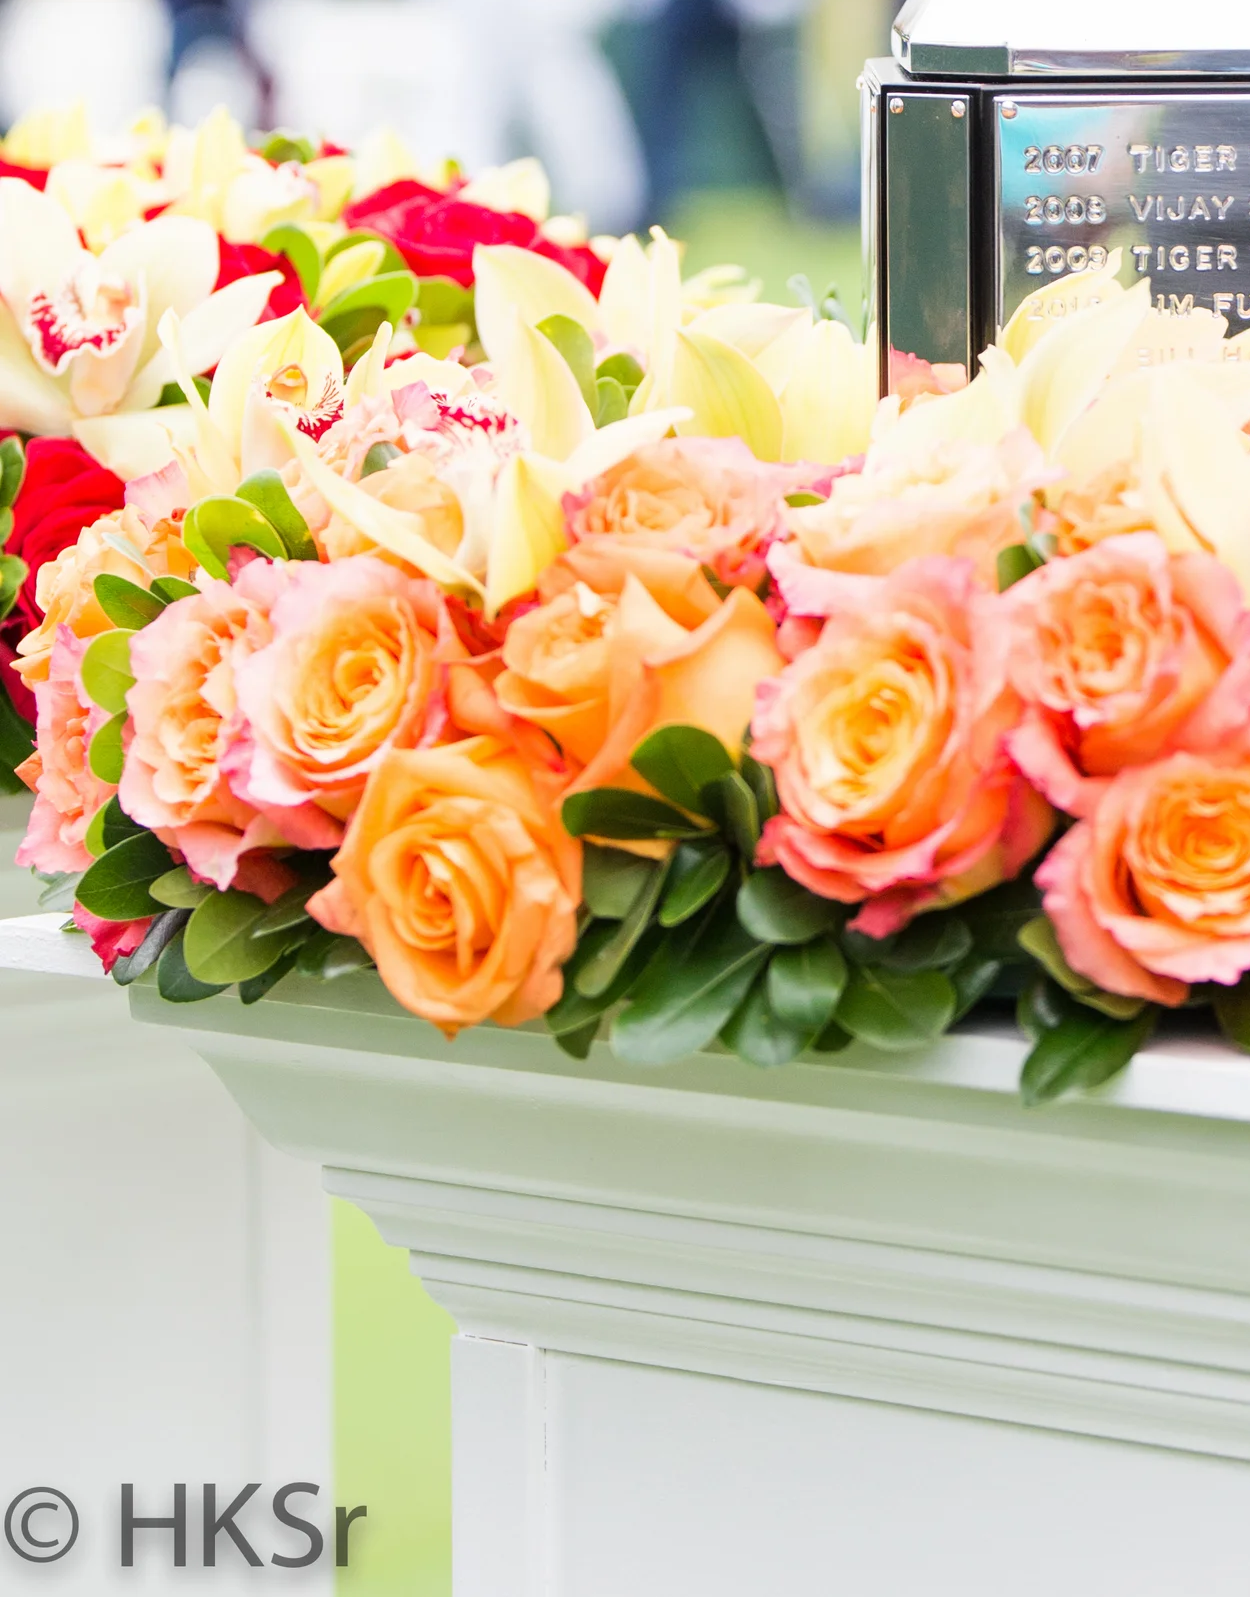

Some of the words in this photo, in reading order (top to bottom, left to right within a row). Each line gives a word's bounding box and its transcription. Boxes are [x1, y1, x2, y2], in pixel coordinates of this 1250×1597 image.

[1024, 145, 1105, 174] 2007
[1127, 144, 1238, 173] TIGER
[1024, 195, 1107, 224] 2008
[1128, 194, 1235, 221] VIJAY
[1026, 245, 1108, 274] 2009
[1131, 245, 1239, 272] TIGER
[1025, 296, 1101, 321] 201
